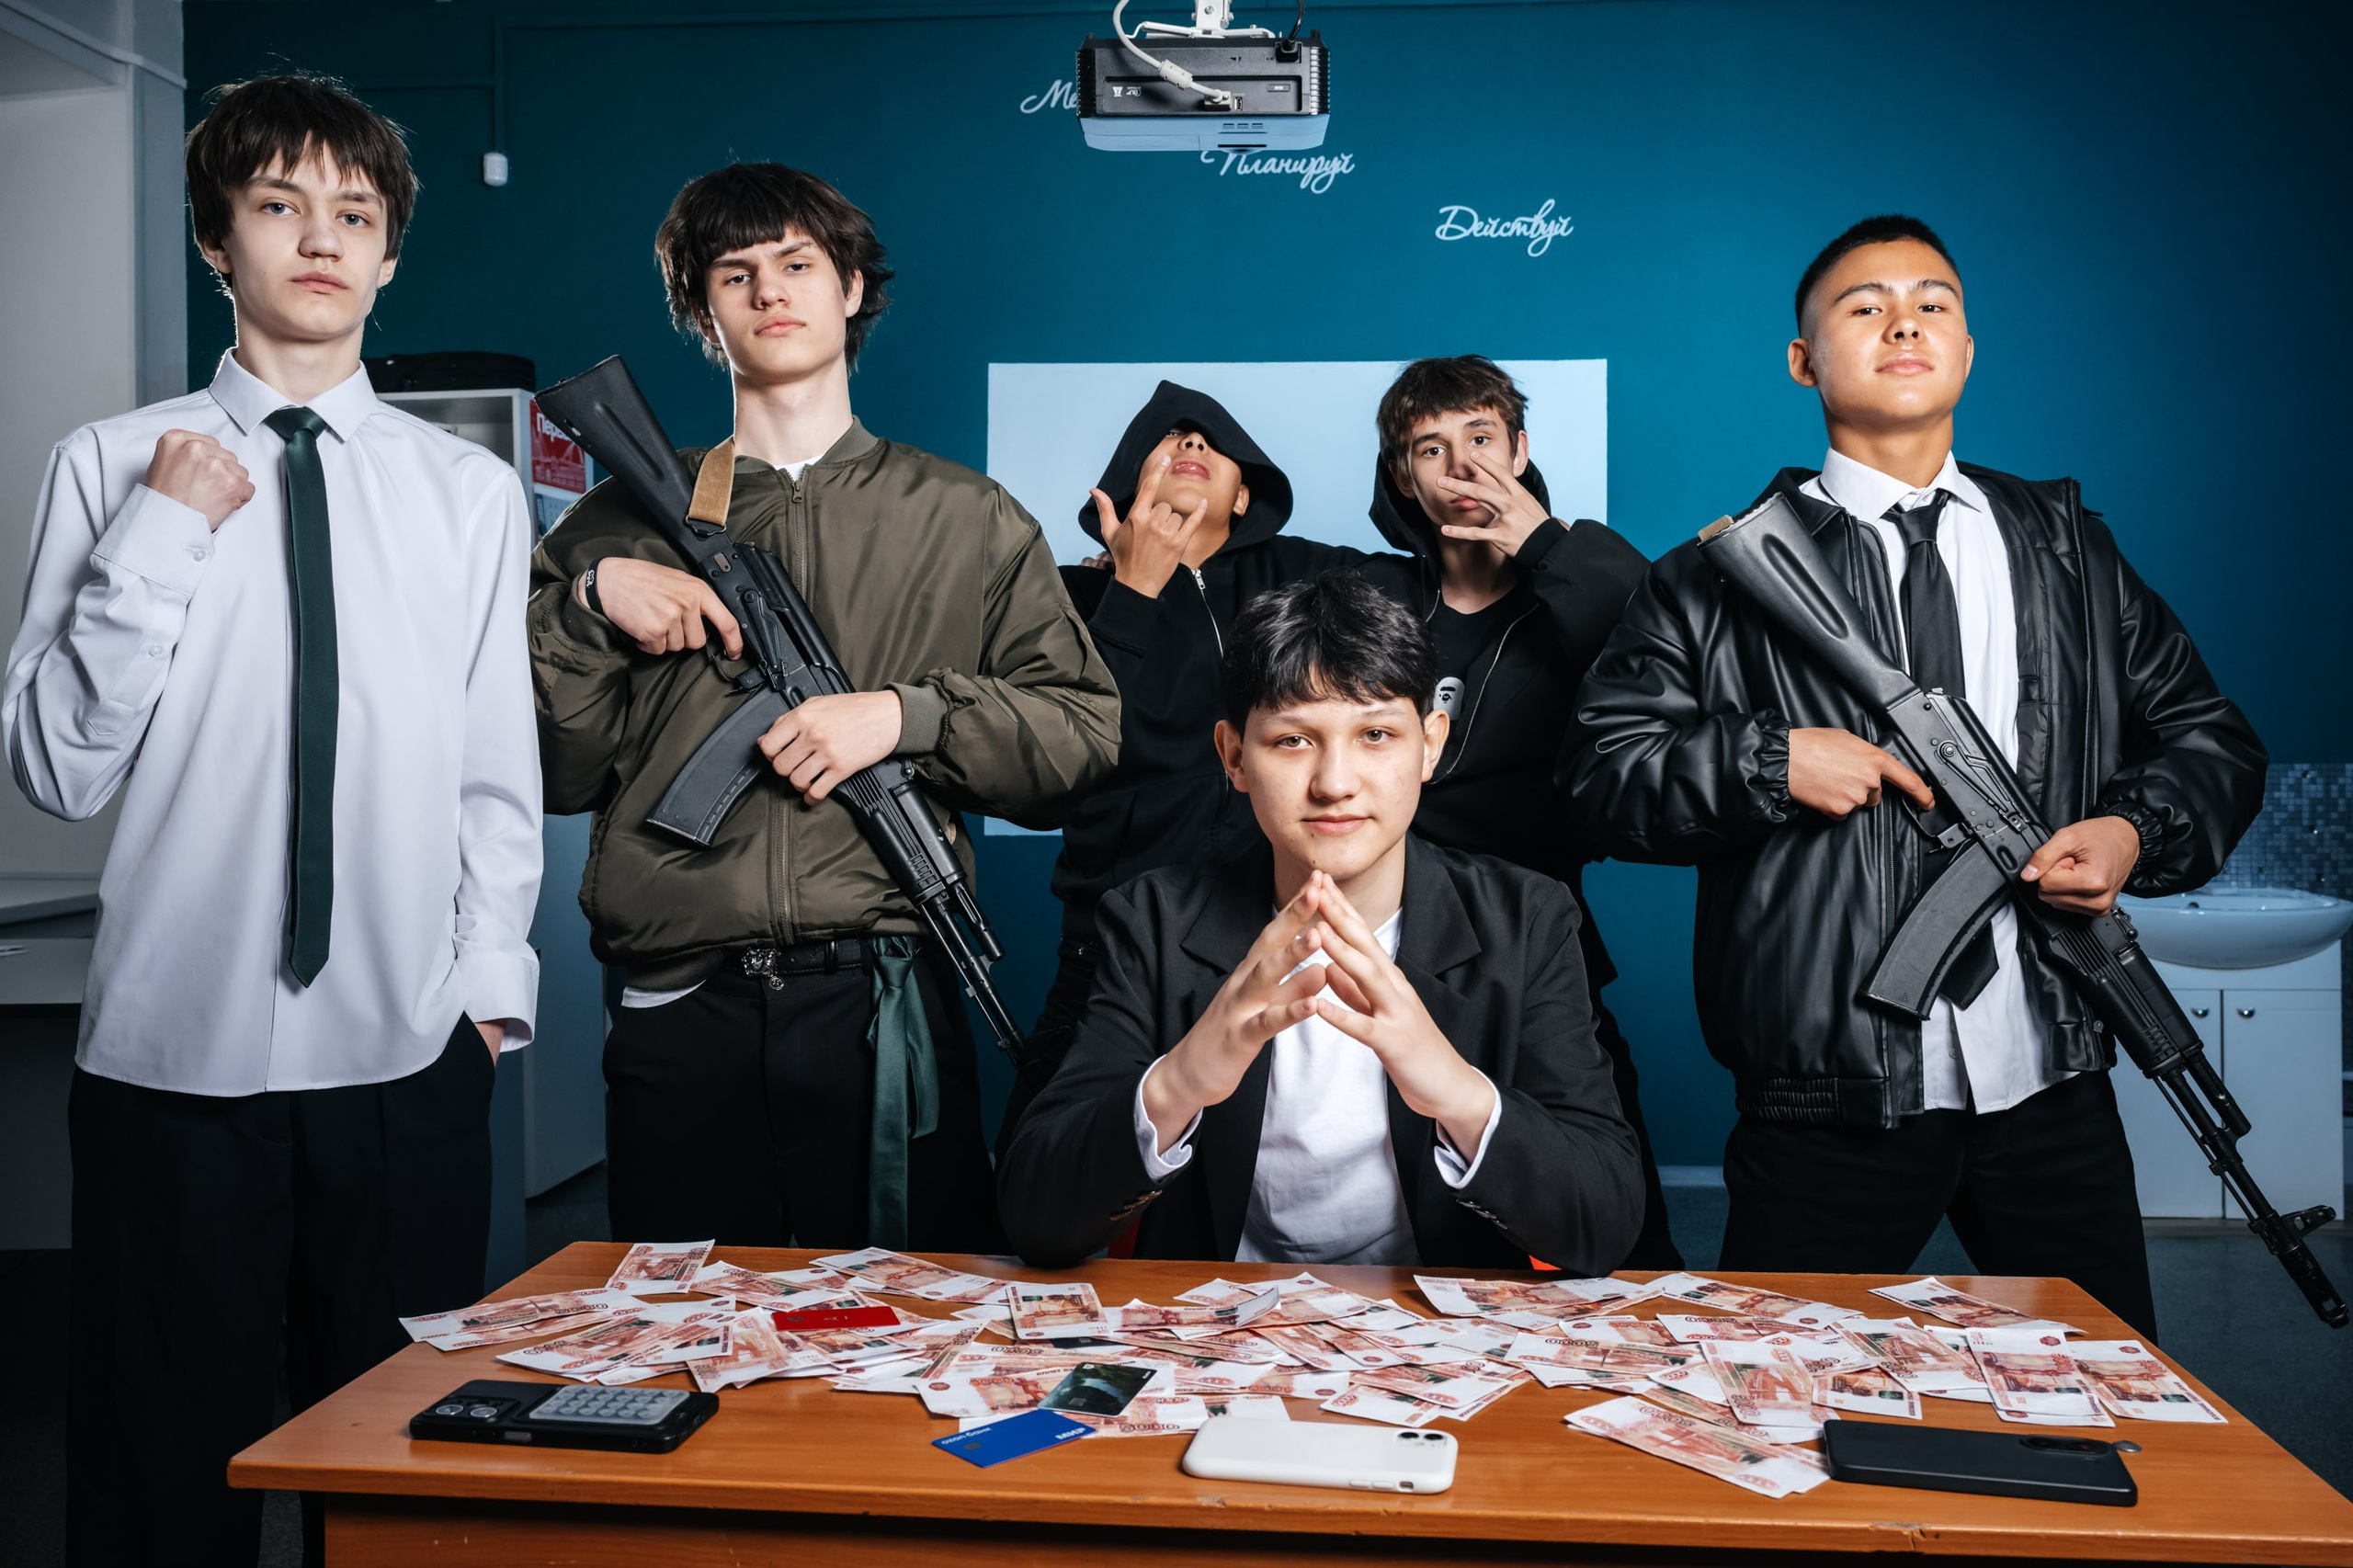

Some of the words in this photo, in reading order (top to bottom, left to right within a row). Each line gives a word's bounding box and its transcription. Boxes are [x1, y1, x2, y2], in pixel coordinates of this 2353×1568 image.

[1200, 149, 1356, 194] Планируй
[1435, 199, 1574, 257] Действуй
[1054, 1426, 1087, 1441] МИР
